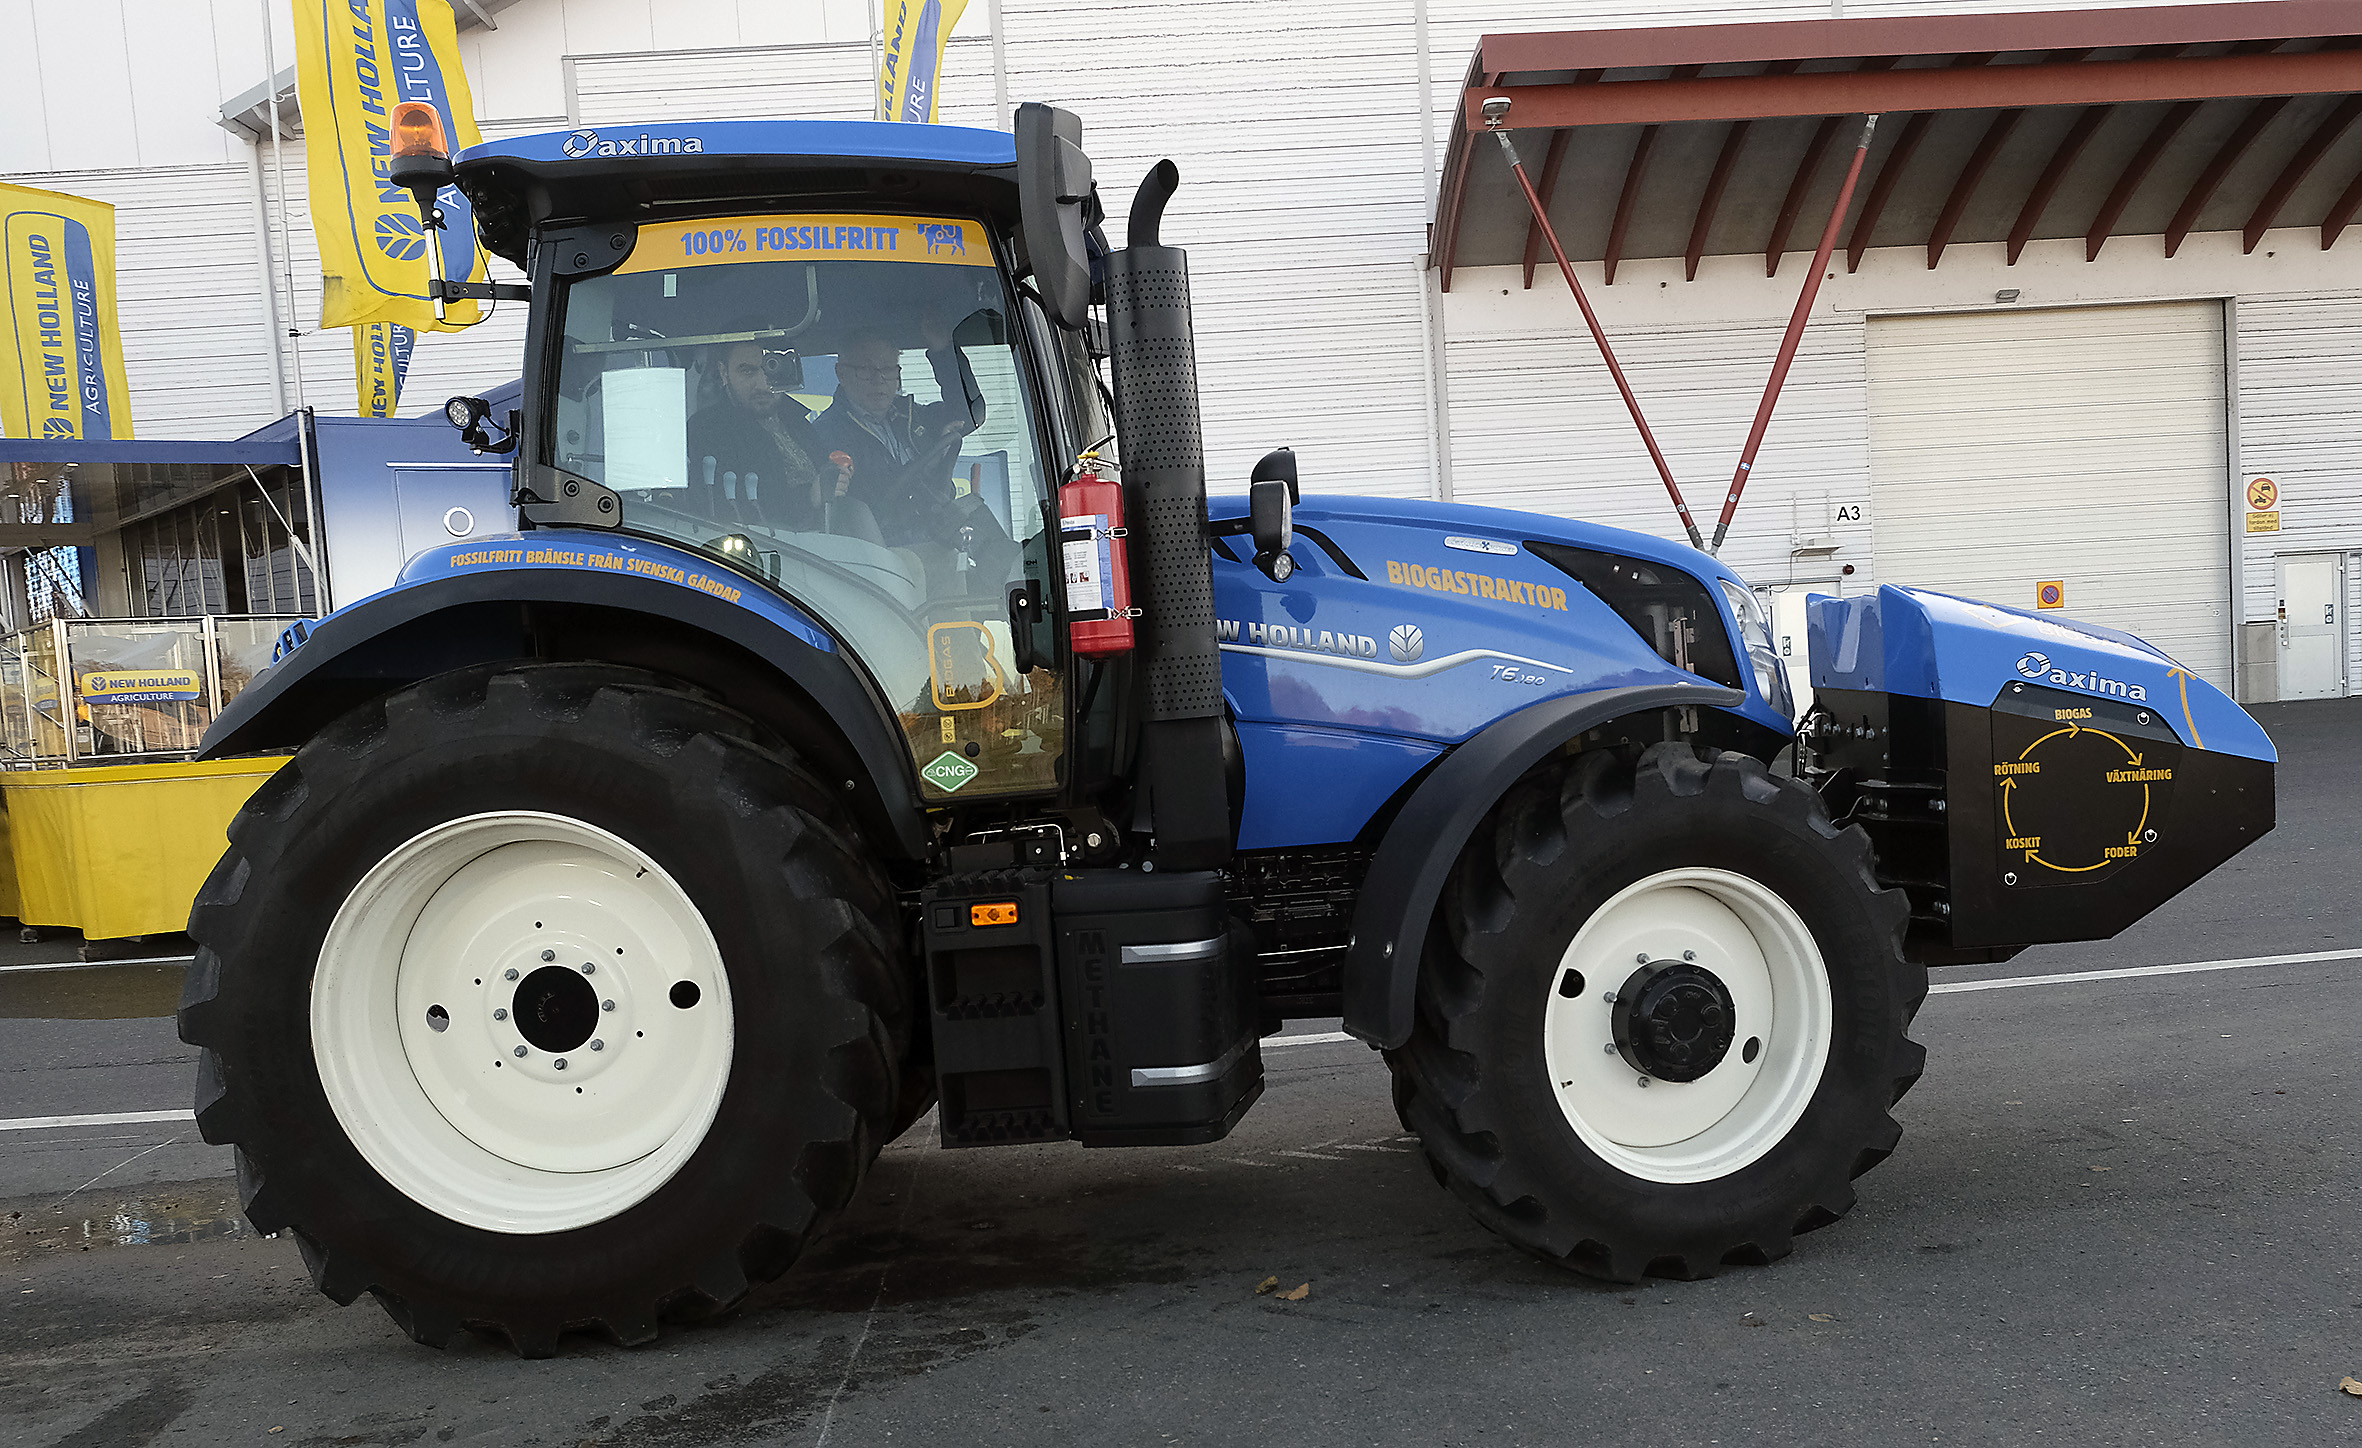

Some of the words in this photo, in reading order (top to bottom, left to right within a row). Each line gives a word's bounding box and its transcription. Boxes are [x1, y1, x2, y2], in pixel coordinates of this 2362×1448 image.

[348, 0, 387, 116] HOLLA
[597, 133, 704, 157] axima
[680, 228, 748, 256] 100%
[755, 225, 900, 252] FOSSILFRITT
[28, 233, 62, 347] HOLLAND
[73, 279, 102, 415] AGRICULTURE
[370, 322, 386, 374] HOLL
[43, 352, 69, 411] NEW
[1836, 505, 1862, 522] A3
[450, 549, 523, 568] FOSSILFRITT
[526, 548, 584, 566] BRÄNSLE
[588, 552, 624, 570] FRÅN
[627, 558, 685, 583] SVENSKA
[687, 573, 742, 603] GÅRDAR
[1386, 560, 1569, 612] BIOGASTRAKTOR
[1248, 622, 1379, 658] HOLLAND
[109, 679, 136, 689] NEW
[138, 676, 191, 687] HOLLAND
[1490, 664, 1546, 686] T6.180
[2049, 668, 2148, 702] axima
[110, 692, 174, 702] AGRICULTURE
[2054, 707, 2093, 720] BIOGAS
[935, 765, 966, 778] CNG
[1994, 761, 2041, 776] RÖTNING
[2106, 767, 2172, 783] VÄXTNÄRING
[2005, 836, 2041, 850] KOSKIT
[2104, 846, 2138, 859] FODER
[1077, 929, 1115, 1115] METHANE
